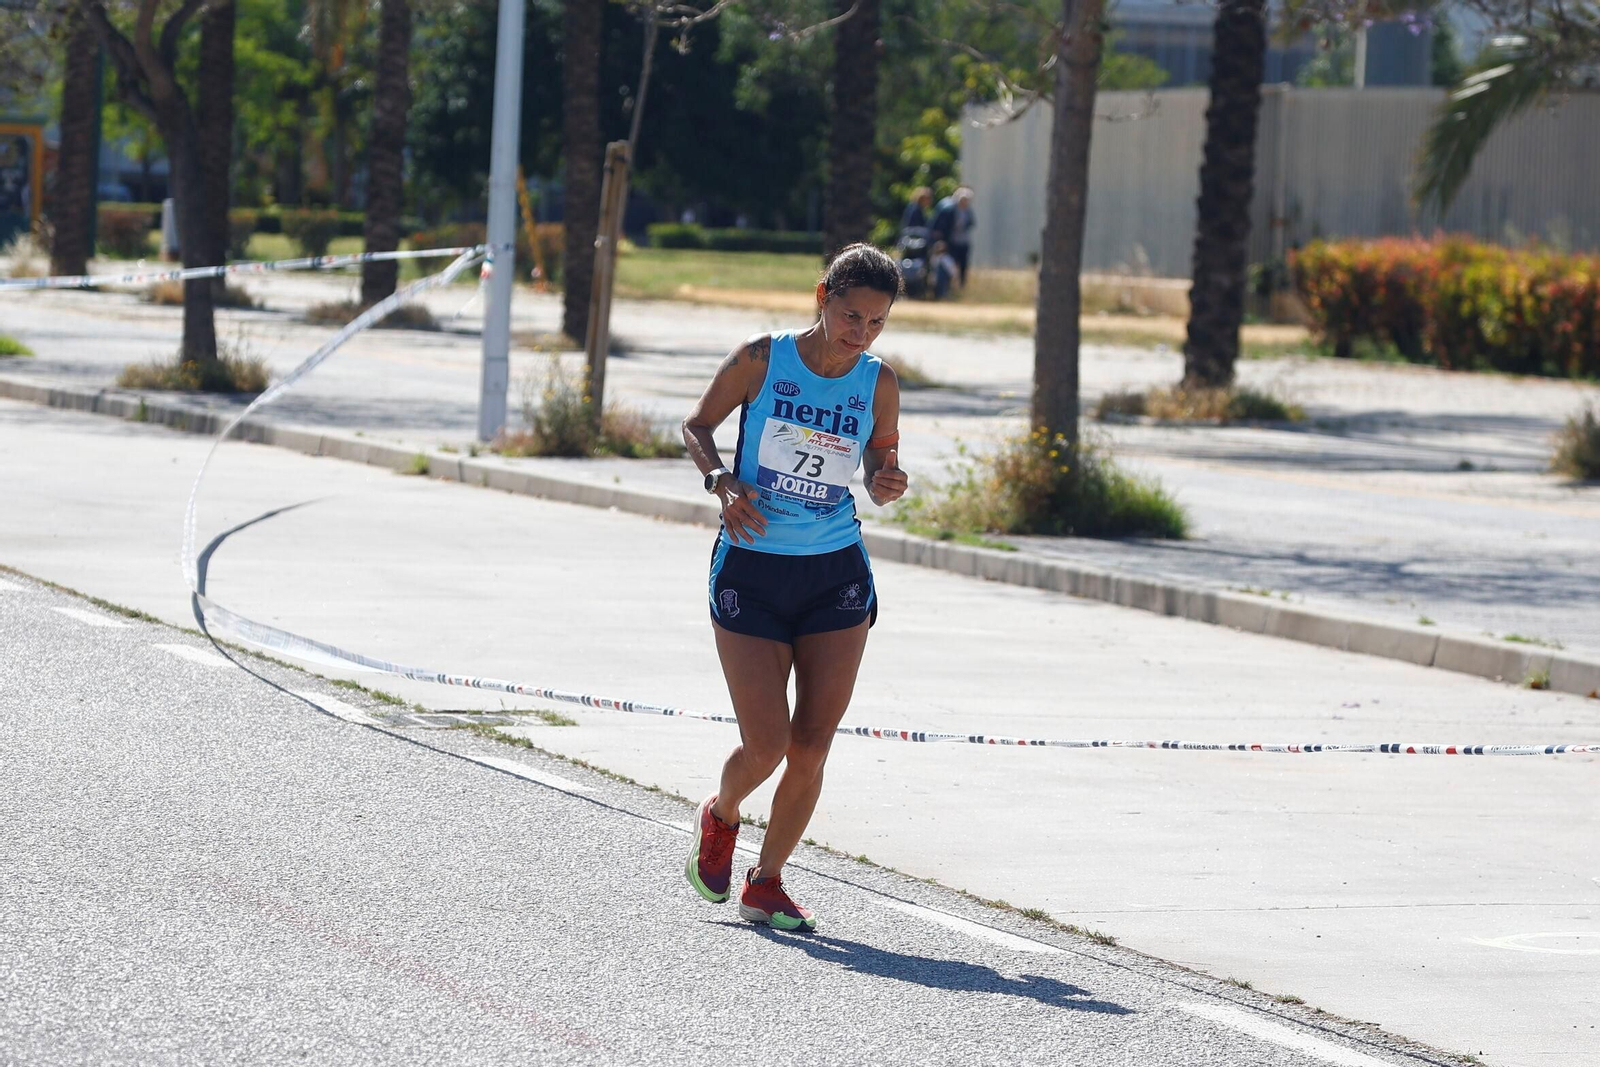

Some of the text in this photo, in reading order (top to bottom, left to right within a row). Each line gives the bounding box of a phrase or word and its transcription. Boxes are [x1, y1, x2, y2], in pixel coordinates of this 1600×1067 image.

[774, 382, 800, 396] TROPS
[773, 398, 859, 435] nerja
[791, 450, 825, 478] 73
